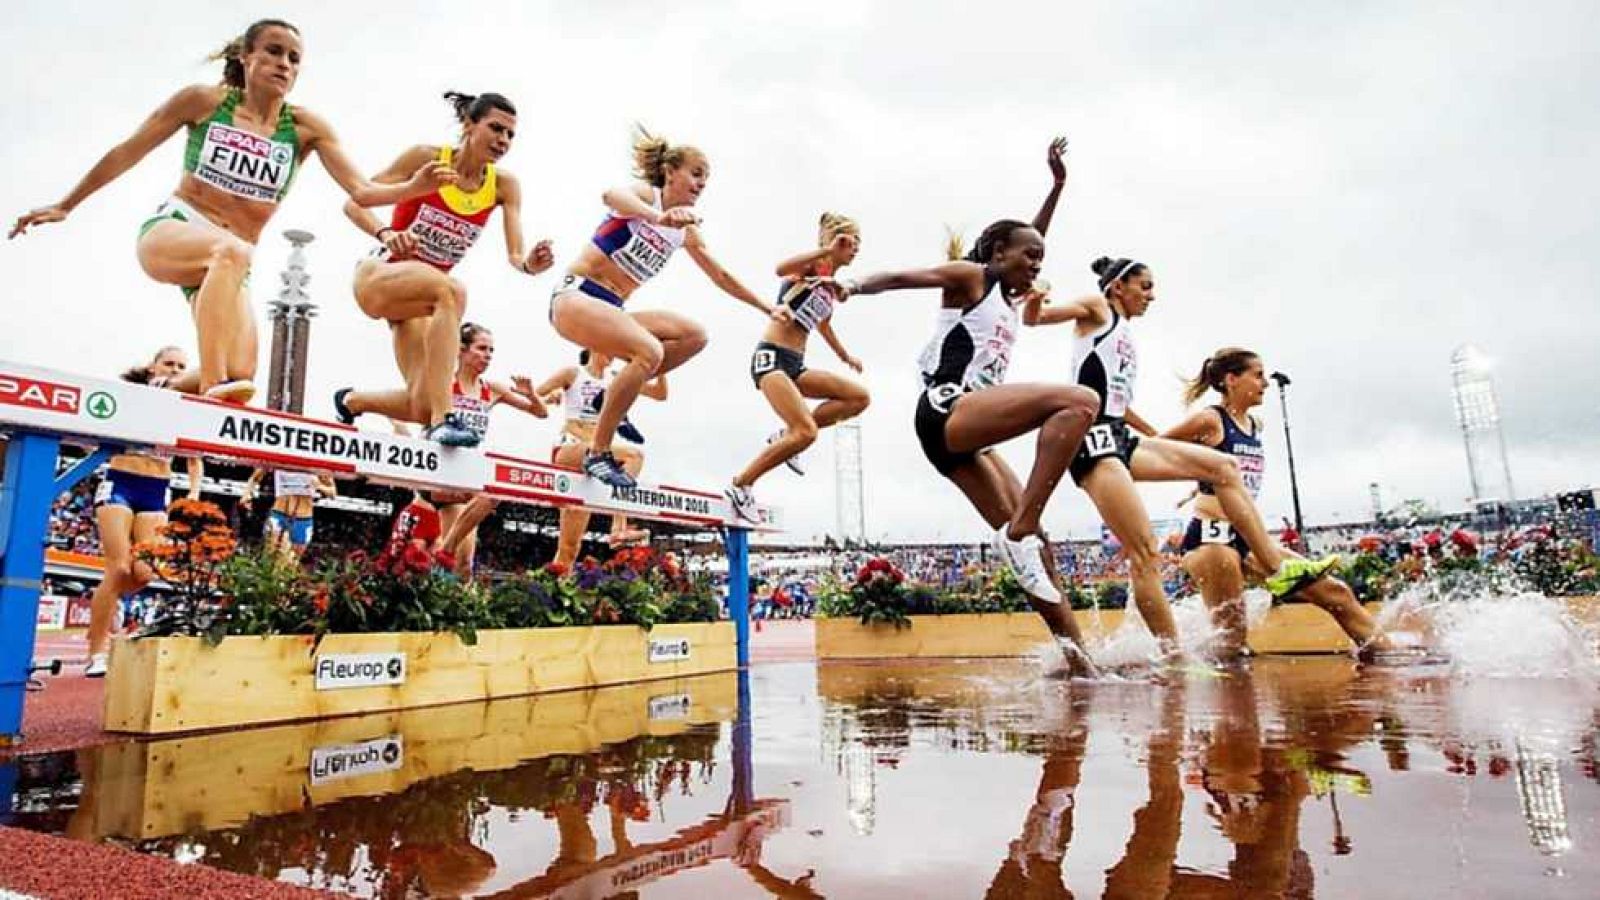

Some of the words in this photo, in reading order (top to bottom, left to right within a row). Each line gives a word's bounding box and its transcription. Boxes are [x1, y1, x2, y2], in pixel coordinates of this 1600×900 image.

[210, 127, 269, 157] SPAR
[210, 146, 280, 183] FINN
[0, 380, 78, 410] PAR
[219, 416, 381, 462] AMSTERDAM
[387, 445, 439, 472] 2016
[1089, 428, 1112, 450] 12
[508, 468, 553, 489] SPAR
[611, 483, 683, 509] AMSTERDAM
[685, 496, 710, 514] 2016
[1209, 520, 1221, 538] 5
[319, 658, 383, 680] Fleurop
